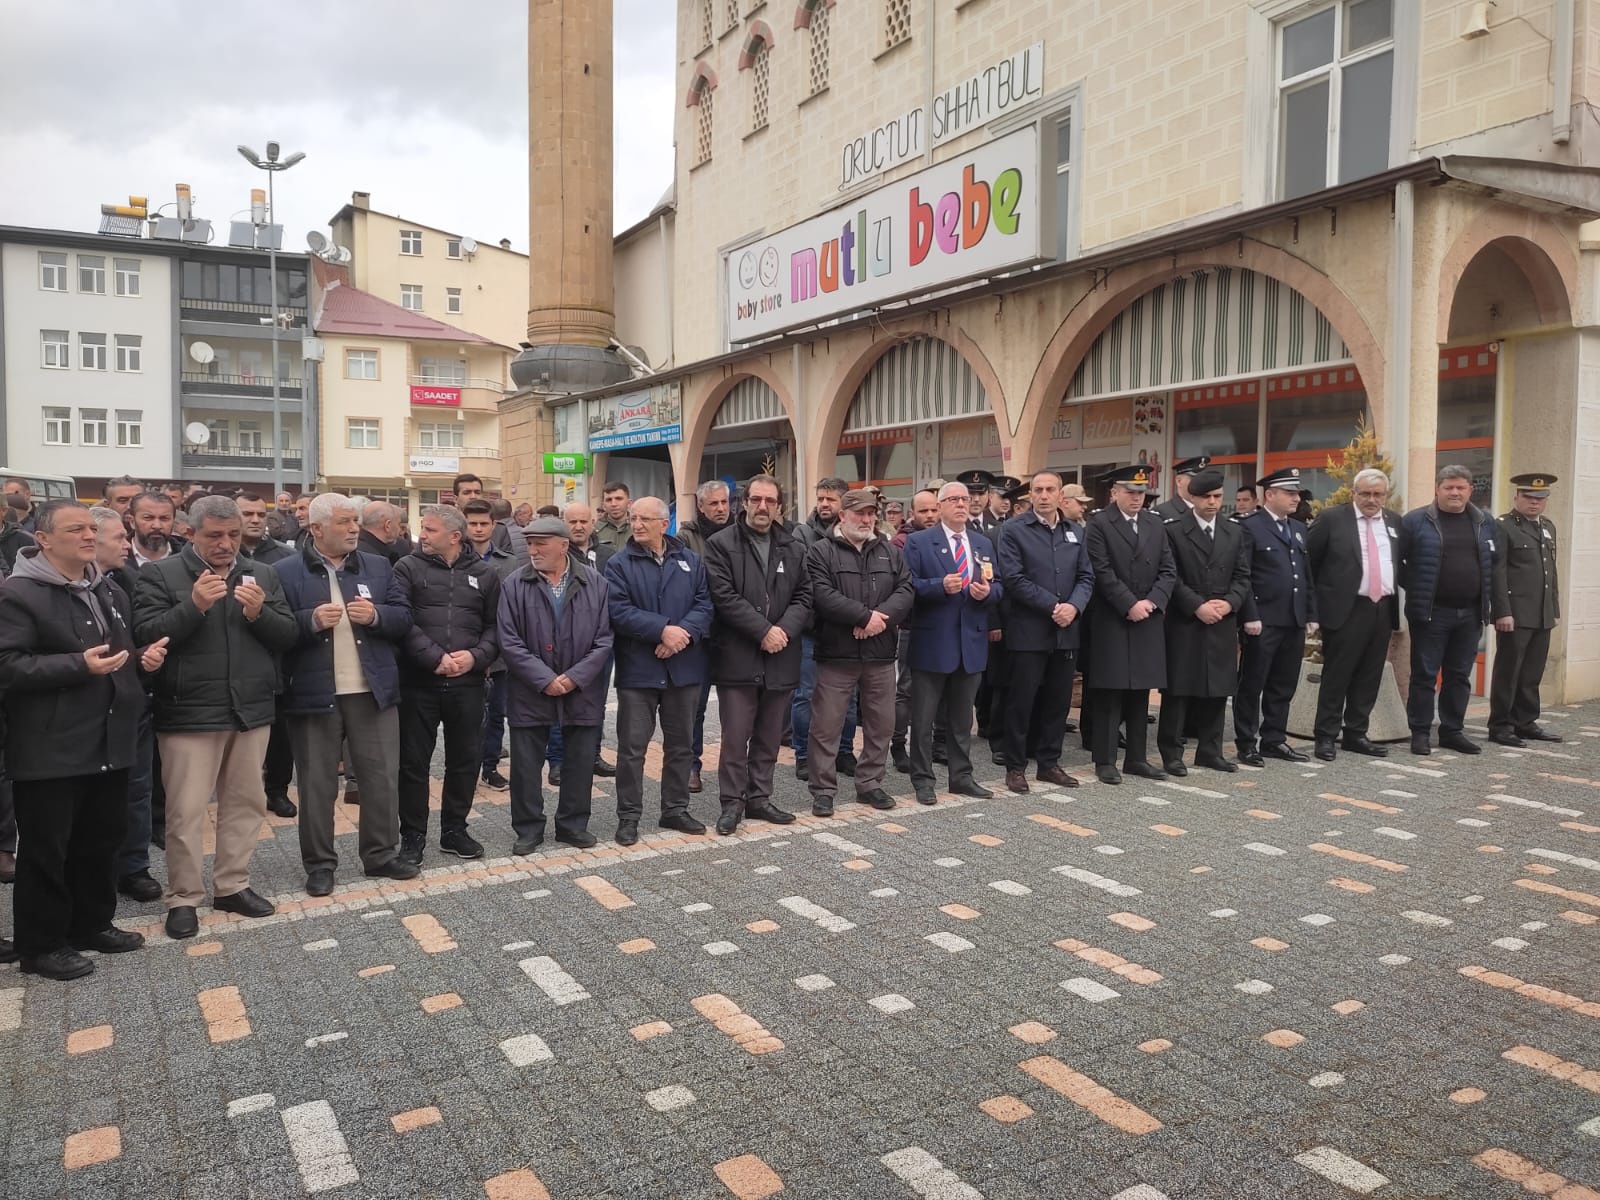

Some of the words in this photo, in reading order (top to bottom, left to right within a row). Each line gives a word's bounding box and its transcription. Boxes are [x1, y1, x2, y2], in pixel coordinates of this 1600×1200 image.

[909, 163, 1022, 266] bebe
[737, 299, 757, 320] baby
[760, 293, 782, 314] store
[424, 391, 458, 400] SAADET
[620, 404, 651, 419] ANKARA
[555, 457, 574, 470] uyku
